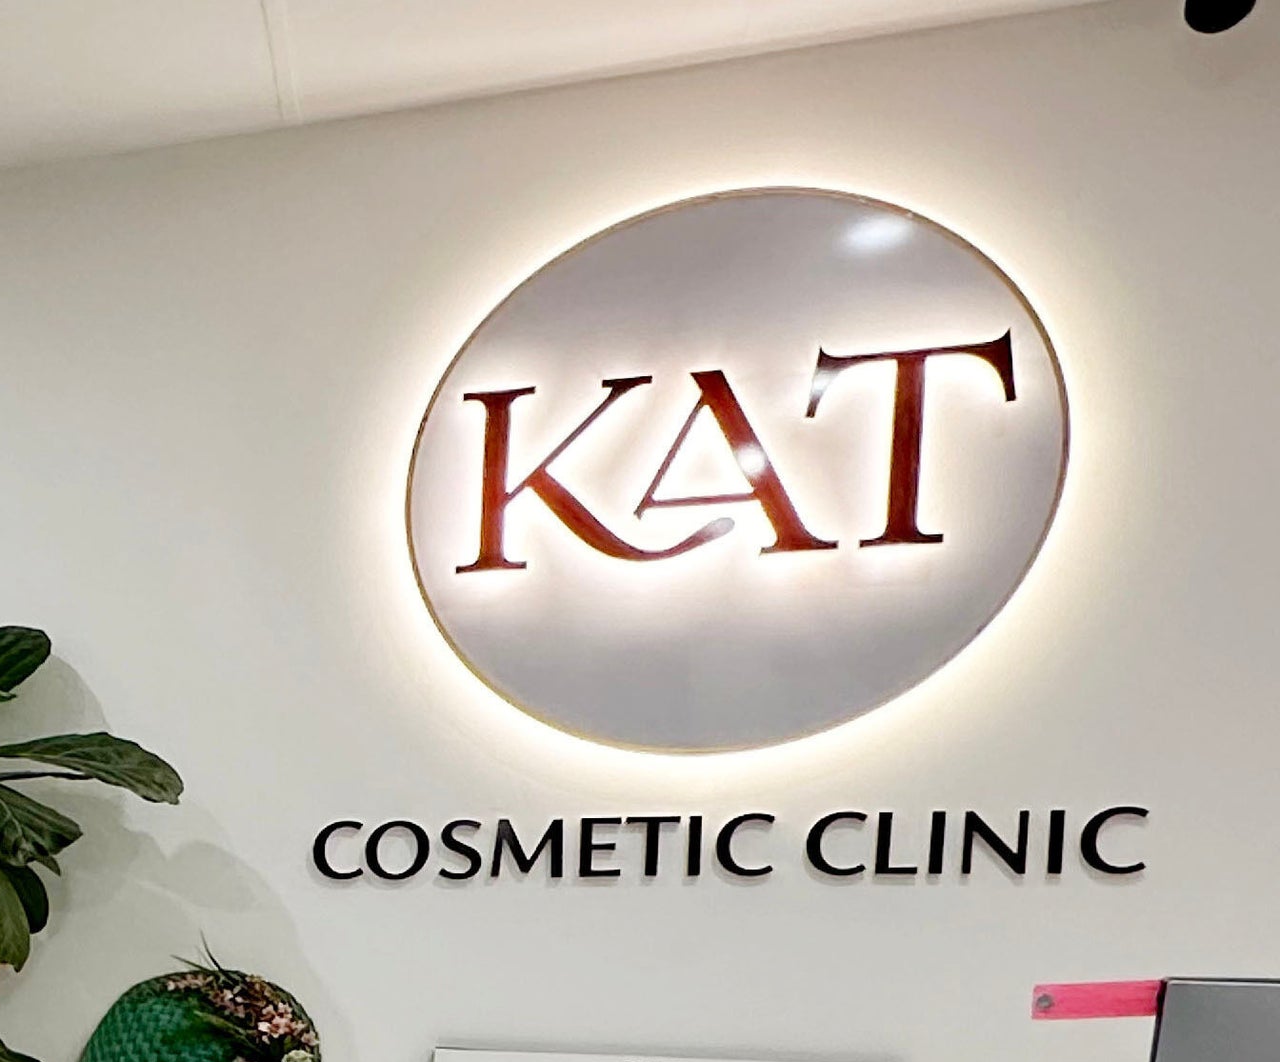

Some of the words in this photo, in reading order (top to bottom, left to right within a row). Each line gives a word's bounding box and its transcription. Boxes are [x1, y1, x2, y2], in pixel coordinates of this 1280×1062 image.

[455, 328, 1017, 574] KAT
[311, 812, 777, 881] COSMETIC
[805, 806, 1151, 877] CLINIC
